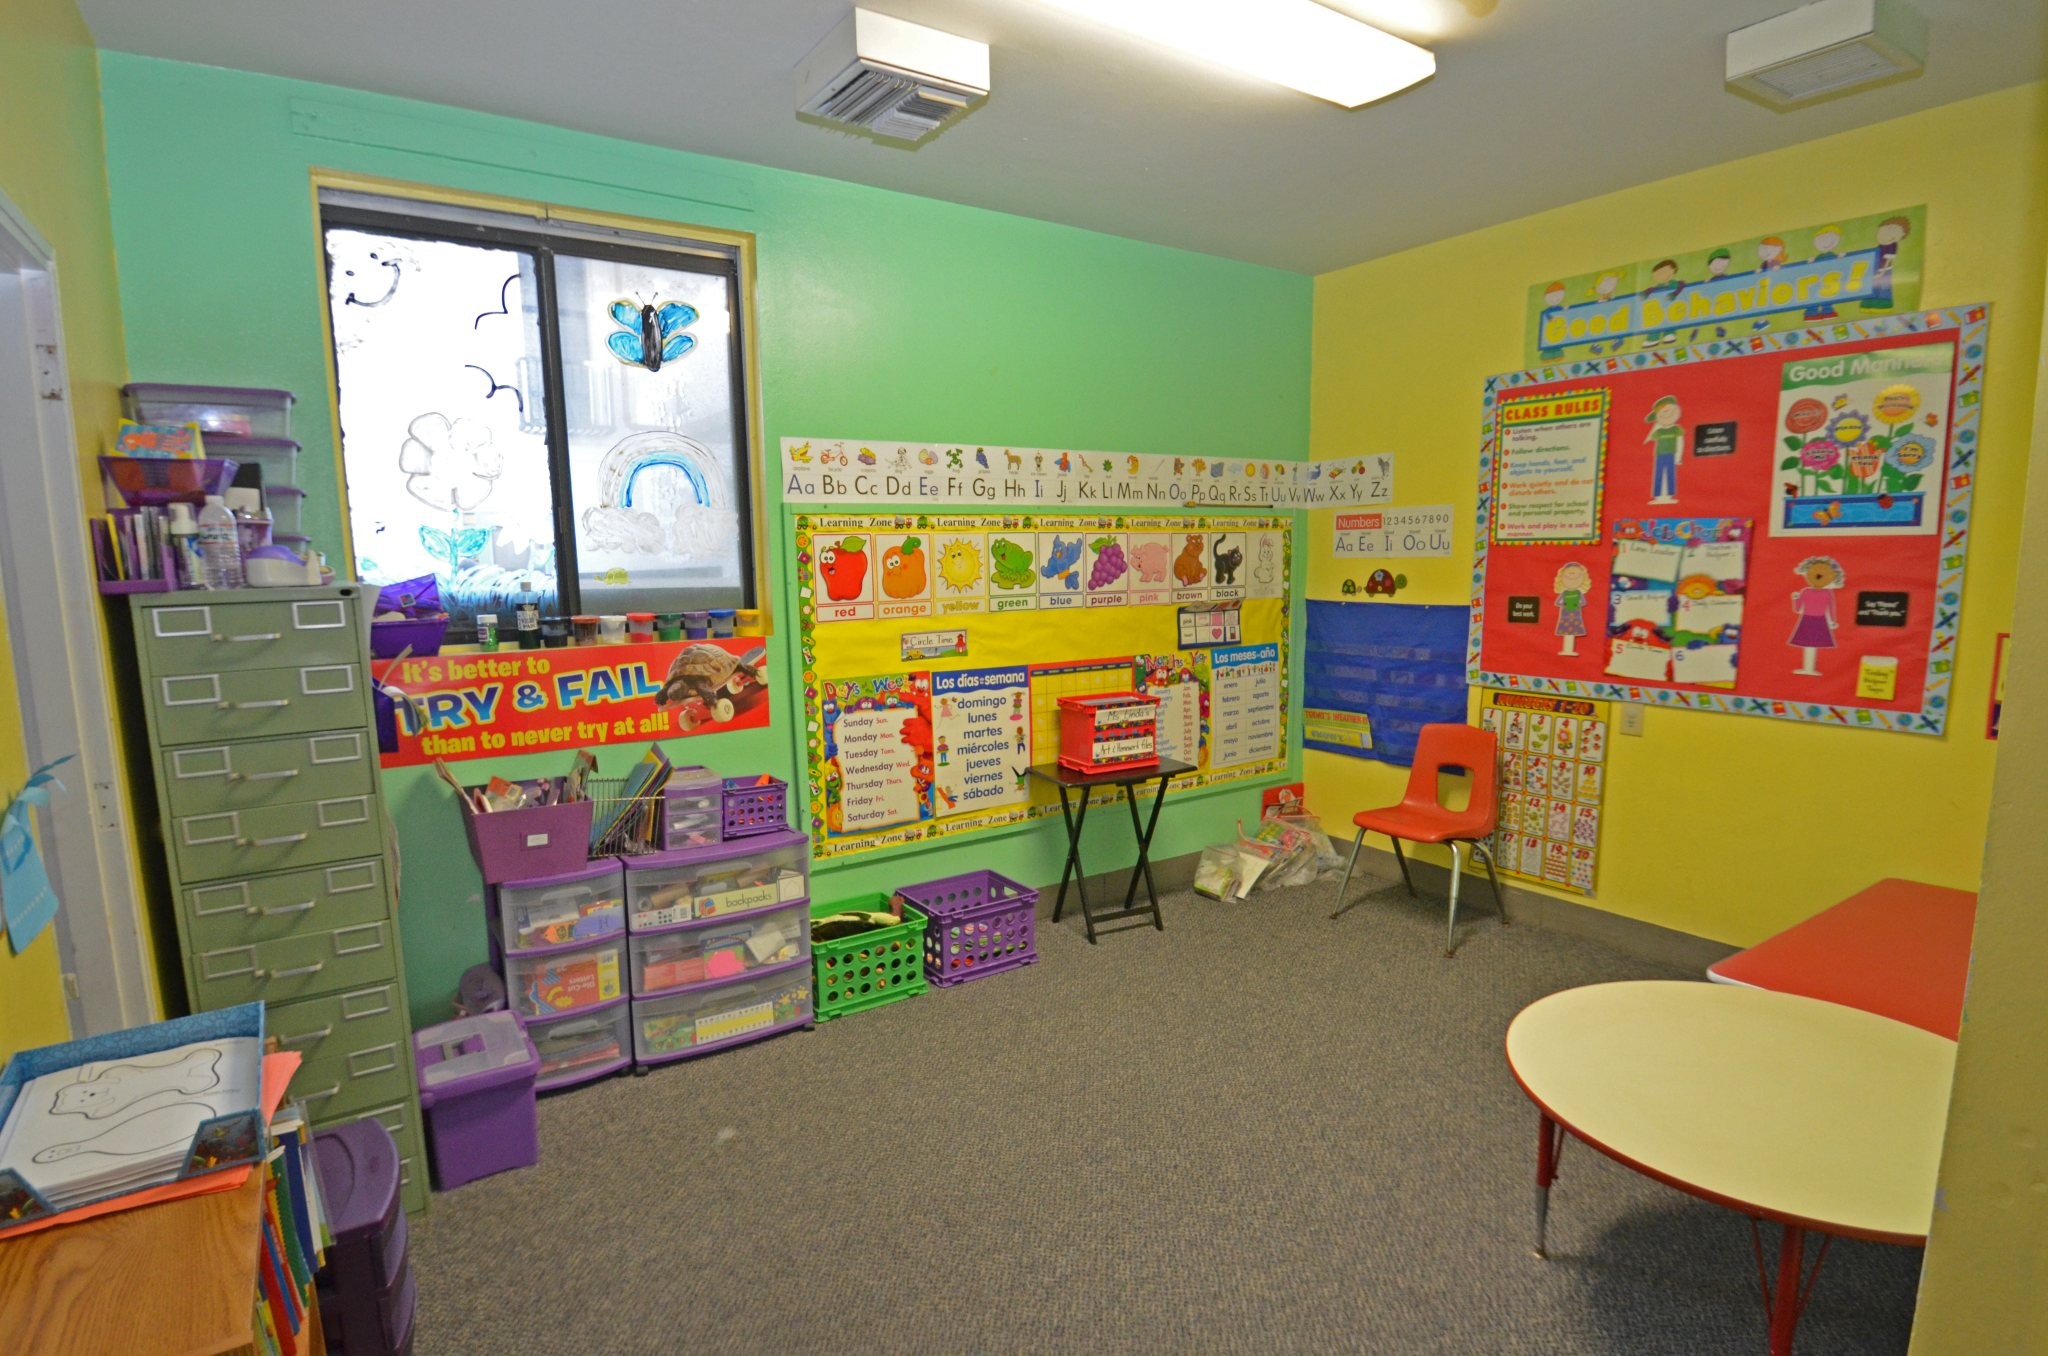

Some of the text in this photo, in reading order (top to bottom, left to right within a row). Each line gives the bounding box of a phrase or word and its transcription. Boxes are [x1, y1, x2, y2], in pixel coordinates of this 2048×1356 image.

[1544, 260, 1869, 343] Good Behaviors!
[1789, 360, 1845, 382] Good
[1505, 399, 1600, 421] CLASS RULES
[820, 518, 892, 528] Learning Zone
[936, 518, 1001, 528] Learning Zone
[1040, 518, 1097, 528] Learning Zone
[1131, 519, 1181, 527] Learning Zone
[1212, 519, 1258, 527] Learning Zone
[1337, 516, 1380, 529] Numbers
[1139, 592, 1159, 602] pink
[1176, 591, 1203, 600] brown
[1216, 588, 1239, 597] black
[997, 599, 1028, 610] green
[1049, 595, 1072, 606] blue
[1091, 595, 1122, 606] purple
[834, 606, 856, 617] red
[883, 604, 927, 616] orange
[942, 600, 980, 614] yellow
[910, 634, 953, 647] Circle Time
[1214, 653, 1229, 664] Los
[1230, 651, 1256, 662] meses
[1260, 647, 1275, 659] año
[1675, 650, 1685, 661] 6
[402, 656, 550, 684] It's better to
[936, 676, 955, 690] Los
[957, 673, 979, 688] días
[985, 672, 1025, 686] semana
[824, 681, 860, 700] Days
[394, 663, 663, 736] TRY & FAIL
[957, 696, 1007, 709] domingo
[843, 718, 874, 728] Sunday
[968, 712, 997, 724] lunes
[421, 711, 670, 756] than to never try at all!
[844, 733, 878, 743] Monday
[963, 727, 1003, 740] martes
[1141, 739, 1153, 749] files
[1224, 737, 1238, 745] mayo
[845, 748, 879, 760] Tuesday
[957, 741, 1009, 756] miércoles
[845, 762, 894, 775] Wednesday
[966, 757, 1001, 772] jueves
[963, 772, 1003, 785] viernes
[1209, 768, 1254, 782] Learning Zone
[846, 779, 884, 791] Thursday
[963, 785, 1004, 800] sábado
[847, 796, 874, 807] Friday
[847, 810, 885, 822] Saturday
[945, 815, 1008, 832] Learning Zone
[834, 833, 903, 853] Learning Zone
[726, 889, 772, 907] backpacks
